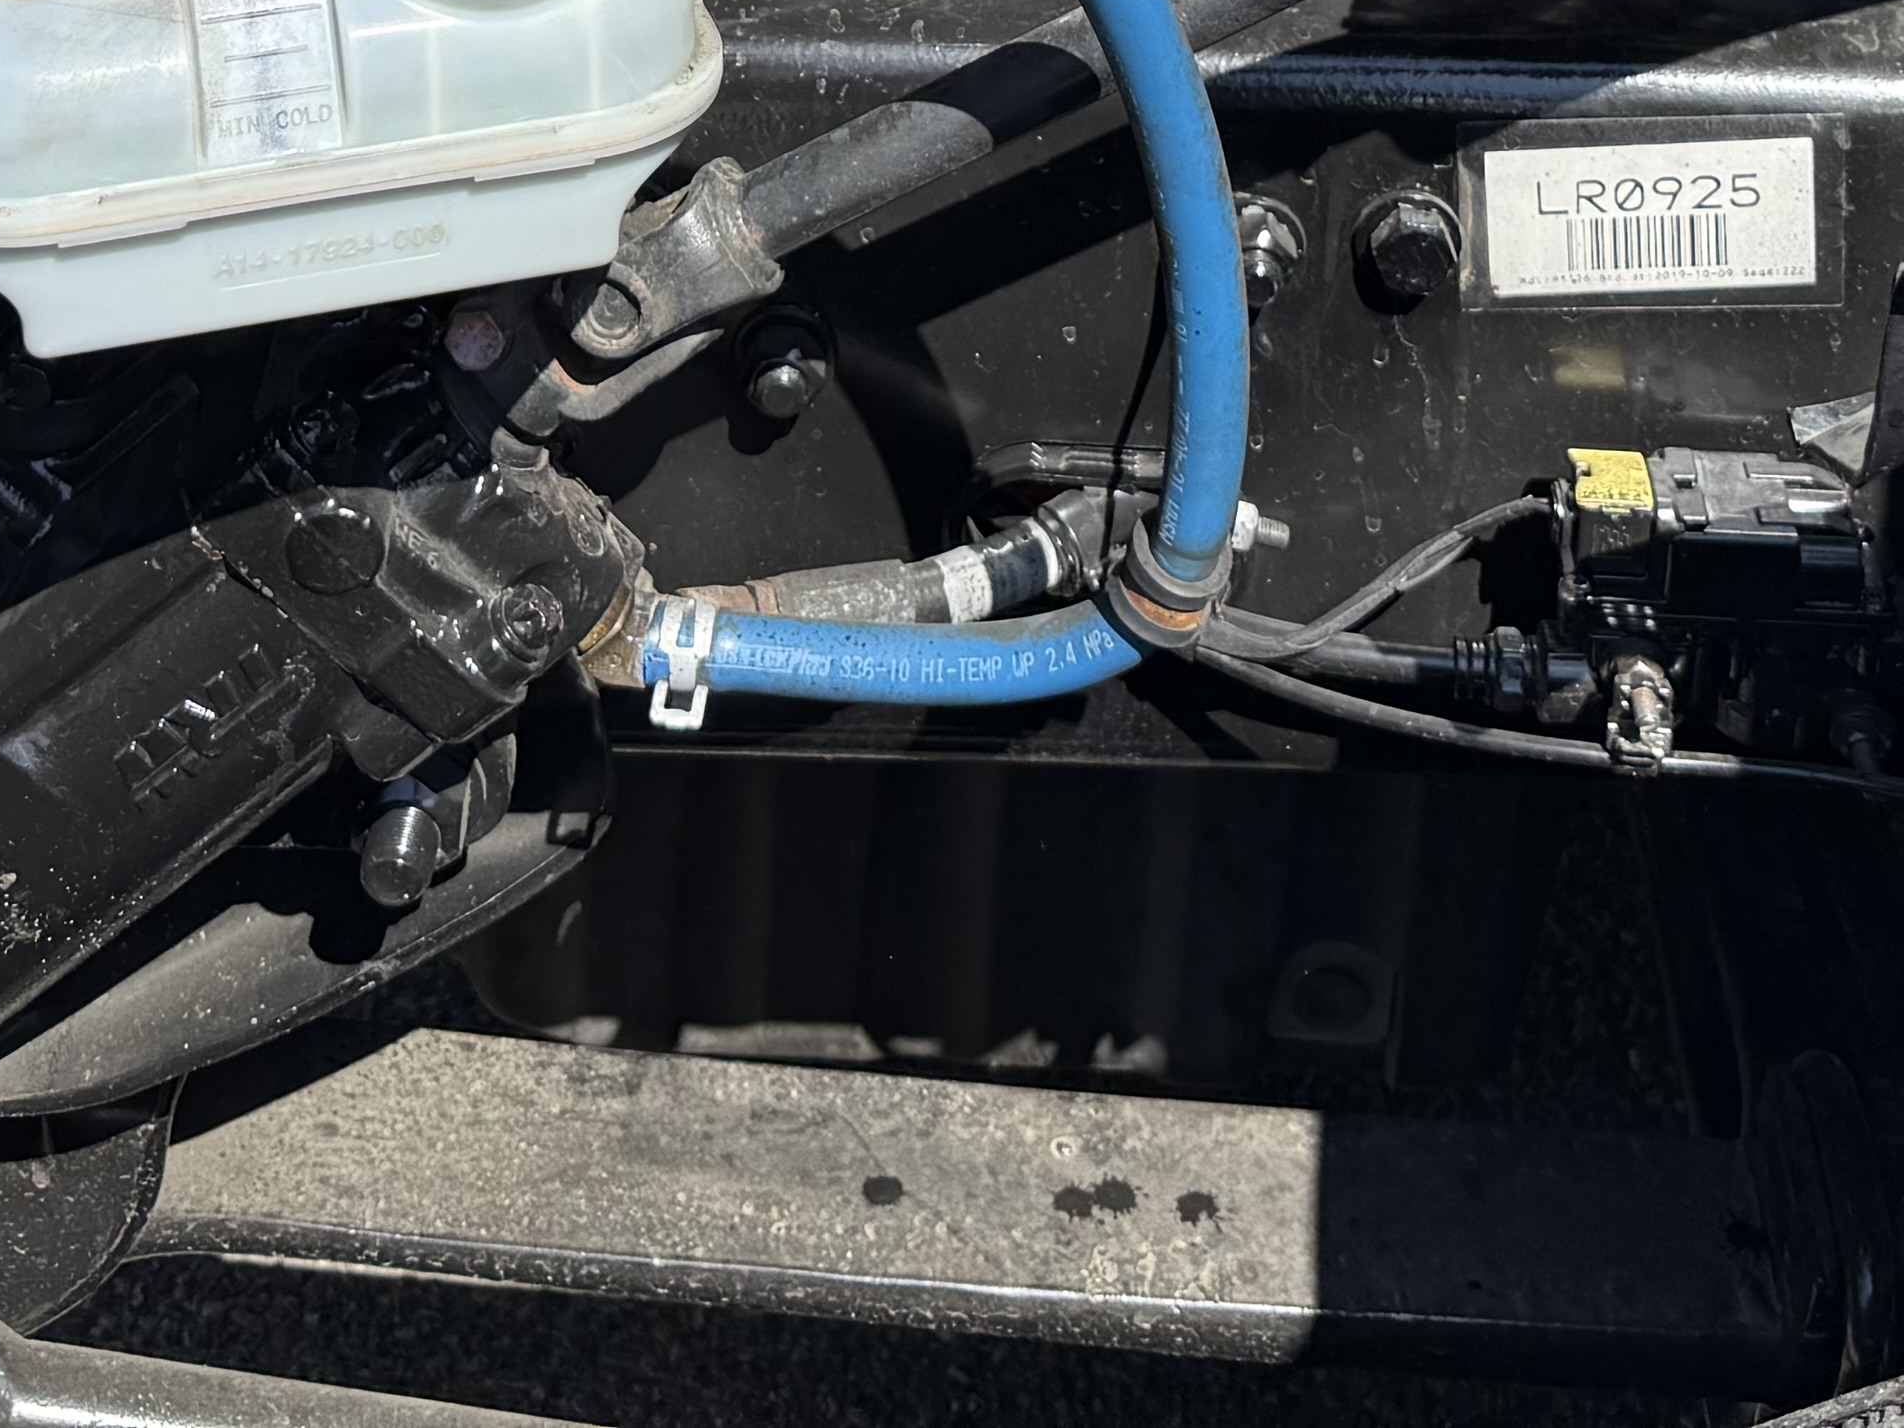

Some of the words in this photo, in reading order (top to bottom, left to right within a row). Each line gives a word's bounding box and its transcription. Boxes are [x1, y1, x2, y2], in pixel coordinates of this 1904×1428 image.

[218, 114, 260, 139] MIN
[276, 104, 333, 129] COLD
[1535, 173, 1762, 217] LR0925
[920, 656, 1002, 684] HI-TEMP
[1082, 629, 1115, 662] MPa
